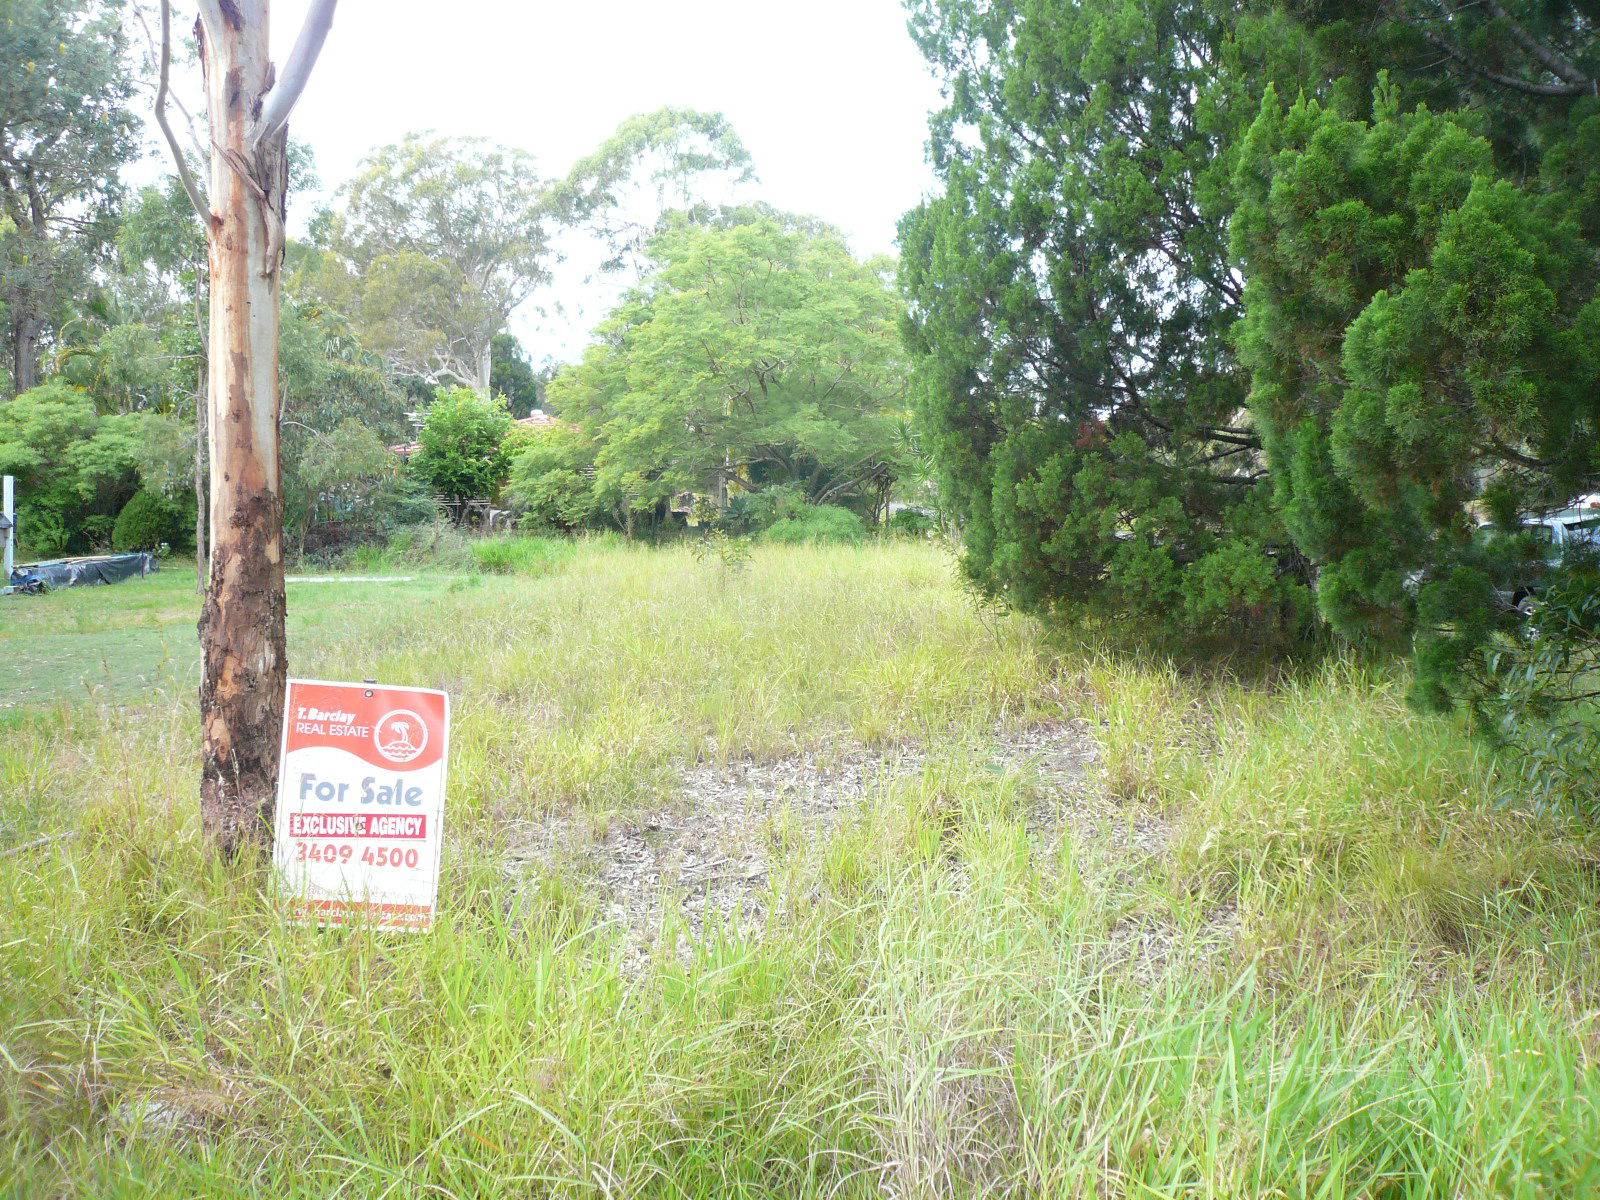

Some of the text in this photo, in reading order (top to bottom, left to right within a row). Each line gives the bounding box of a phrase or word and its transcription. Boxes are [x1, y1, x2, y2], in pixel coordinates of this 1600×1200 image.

[296, 722, 369, 738] REAL ESTATE
[300, 772, 423, 807] For Sale
[292, 815, 423, 836] EXCLUSIVE AGENCY
[295, 841, 419, 869] 3409 4500
